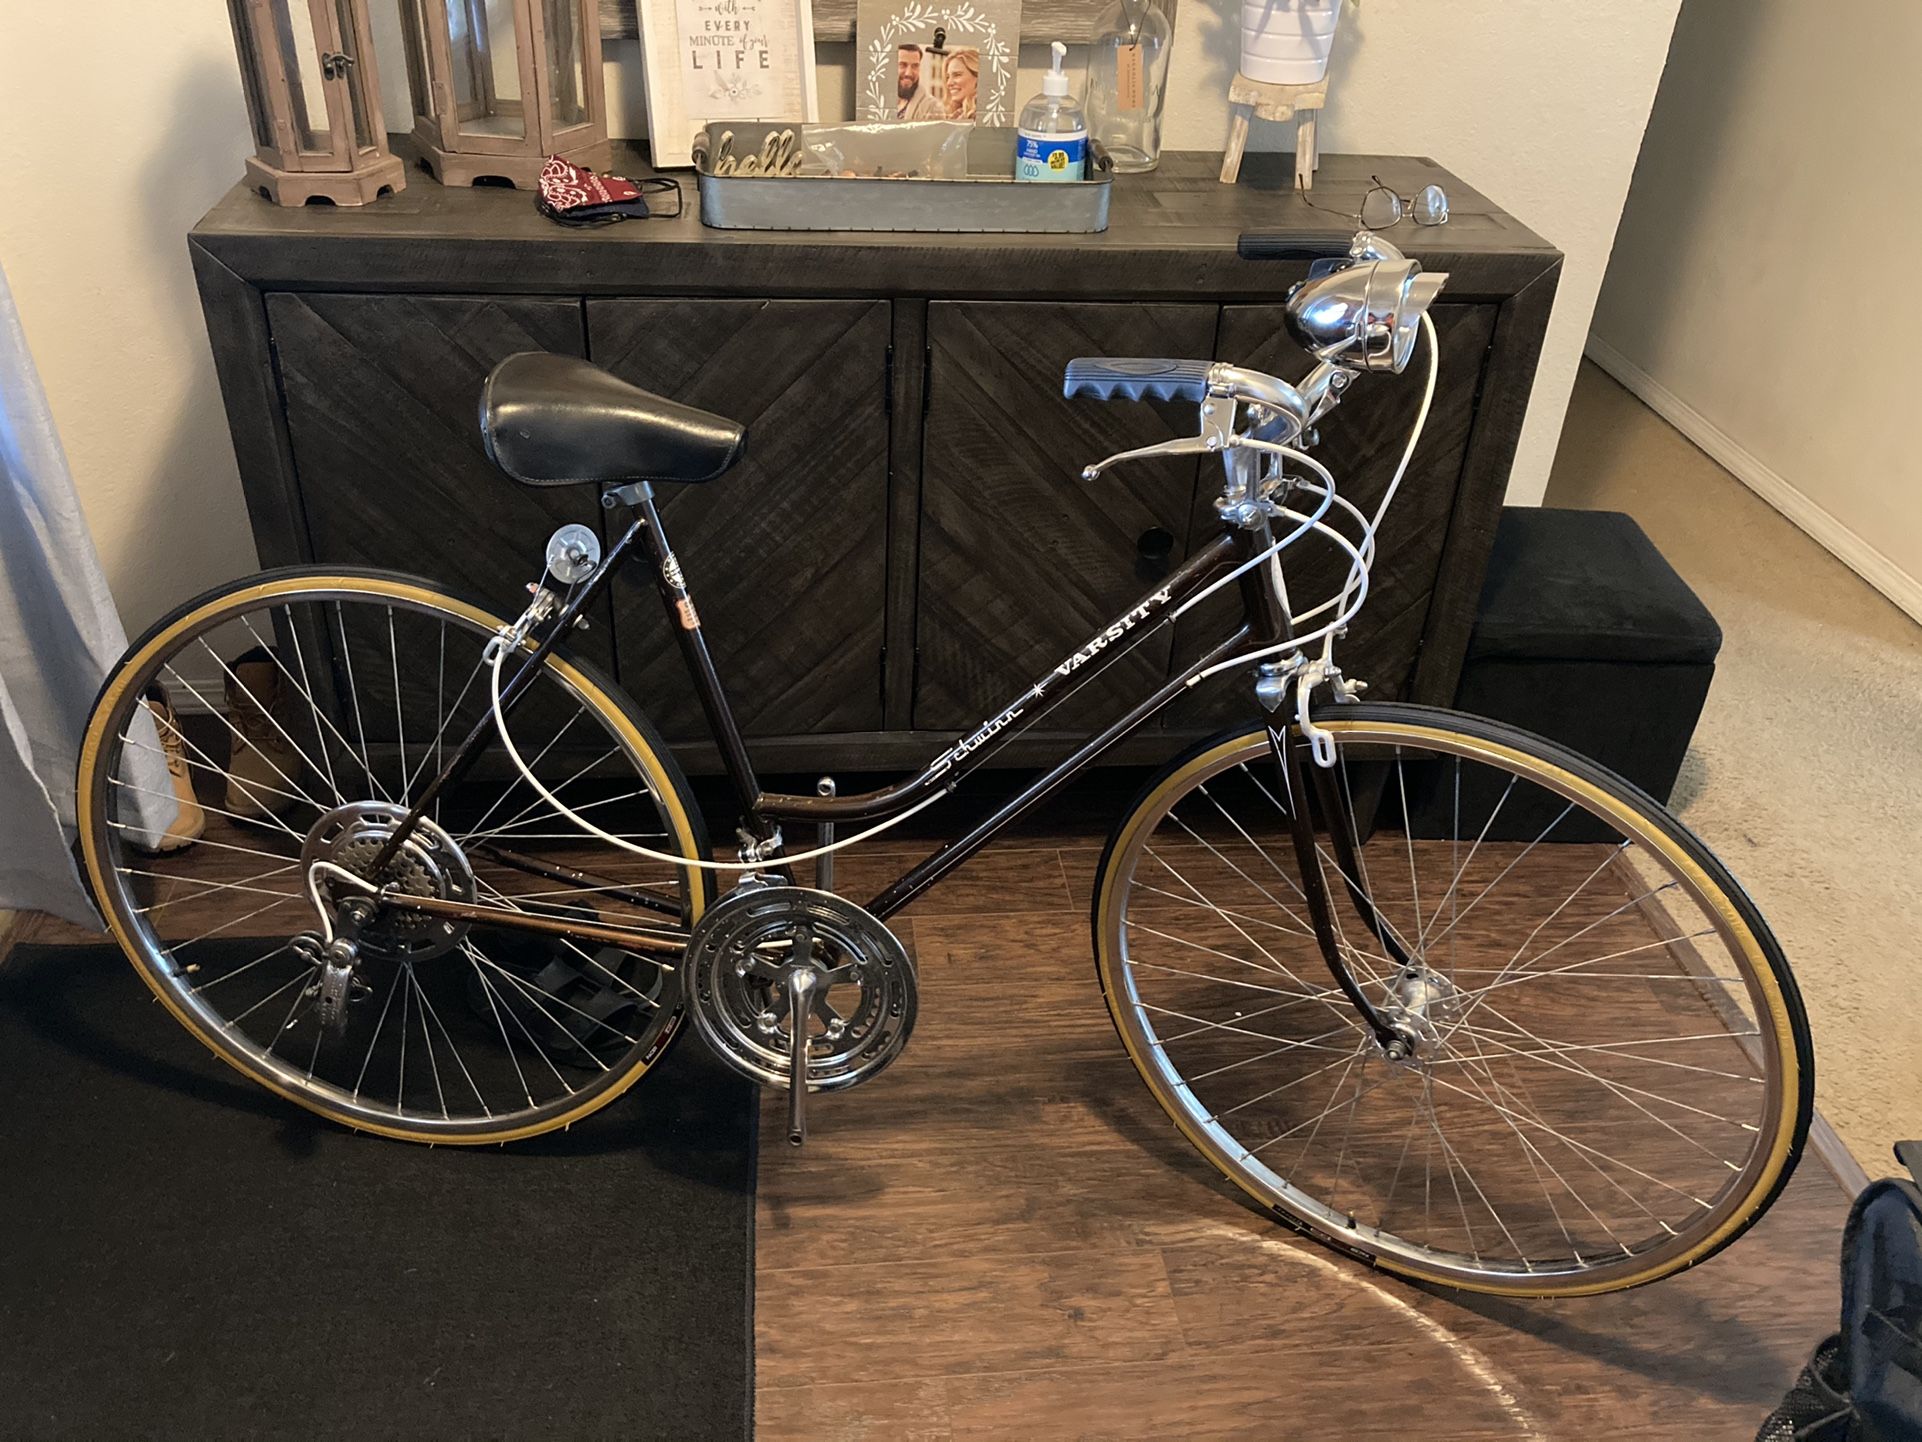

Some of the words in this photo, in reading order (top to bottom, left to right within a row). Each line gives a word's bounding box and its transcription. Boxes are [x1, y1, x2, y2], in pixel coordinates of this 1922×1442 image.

[704, 20, 750, 31] EVERY
[689, 35, 735, 46] MINUTE
[692, 50, 769, 69] LIFE
[925, 708, 1024, 785] Schwinn
[1055, 585, 1171, 675] VARSITY
